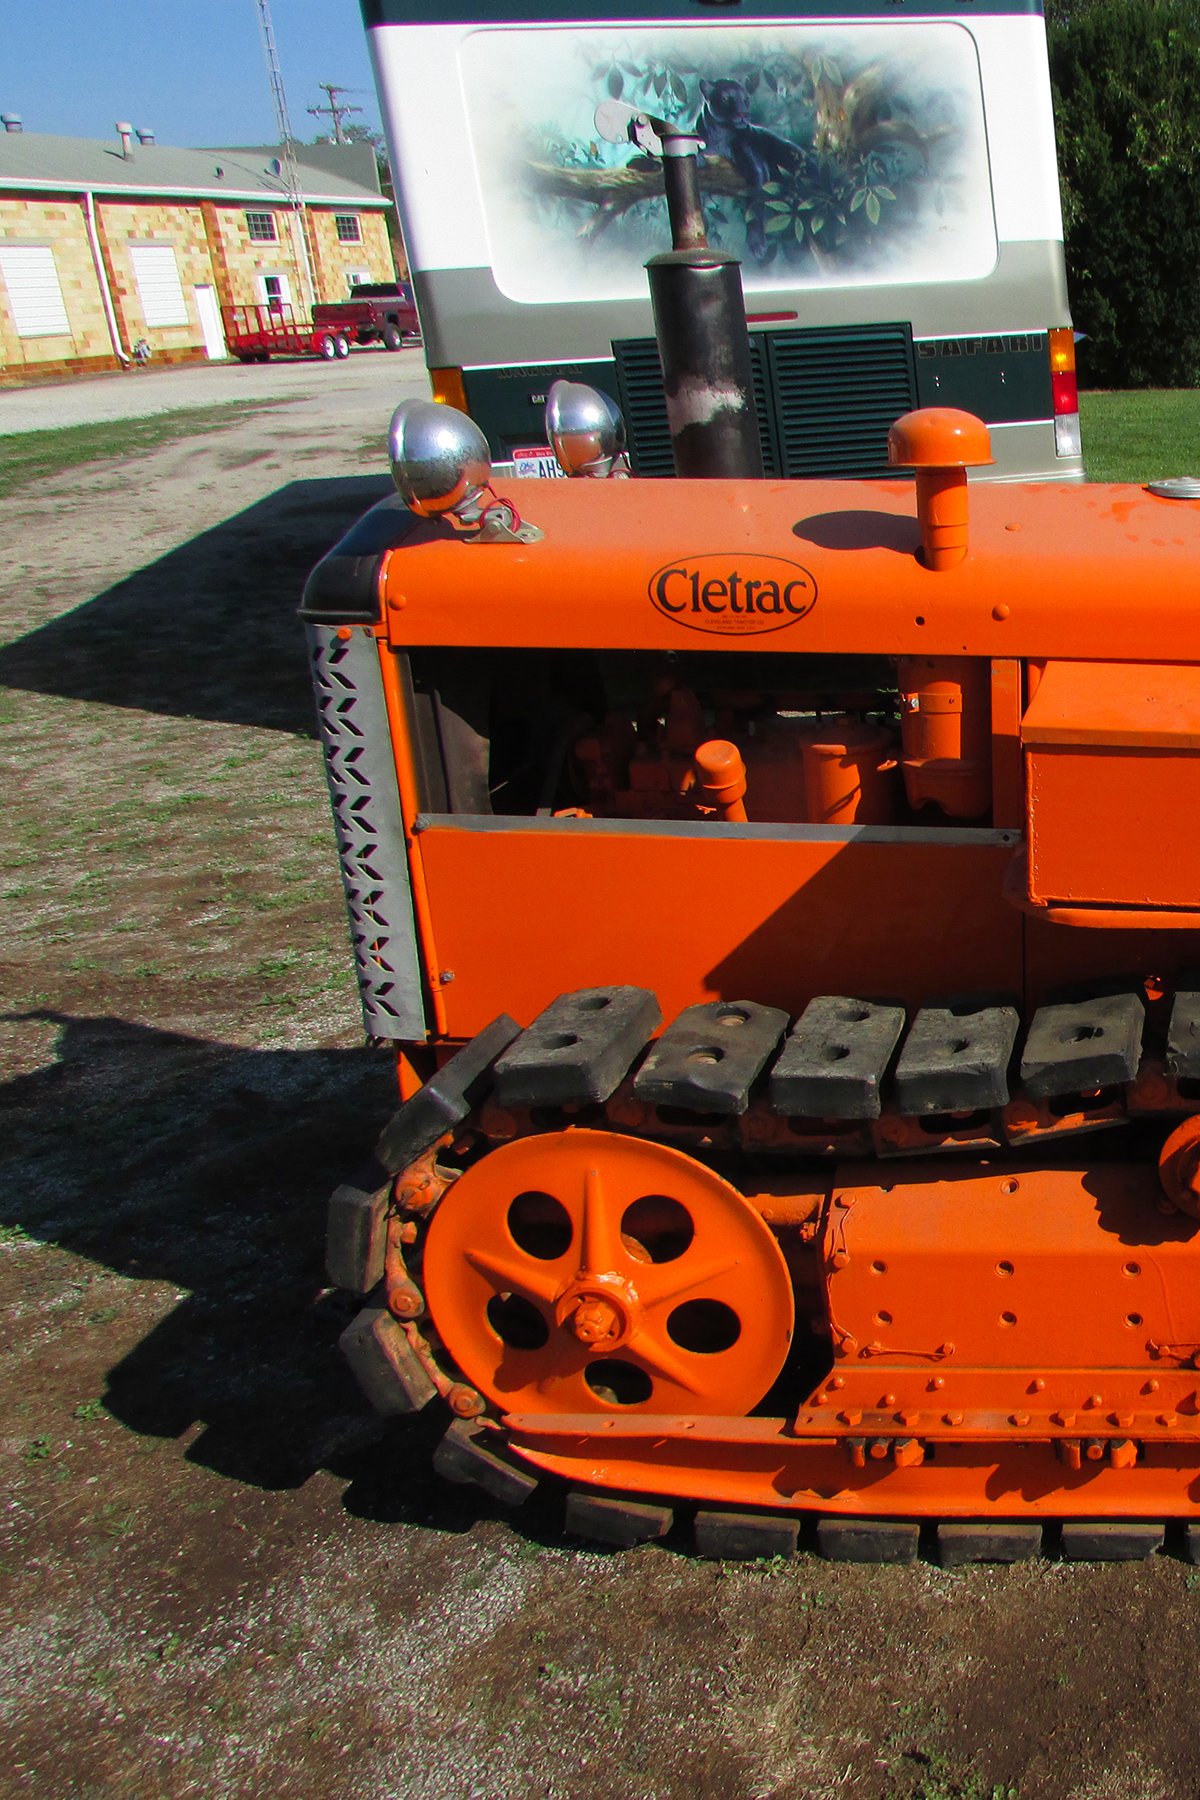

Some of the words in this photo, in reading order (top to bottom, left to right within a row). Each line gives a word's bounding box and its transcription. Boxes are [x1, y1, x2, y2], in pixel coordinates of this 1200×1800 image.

[917, 332, 1043, 359] SAFARI
[531, 394, 545, 404] CAT
[656, 568, 808, 614] Cletrac
